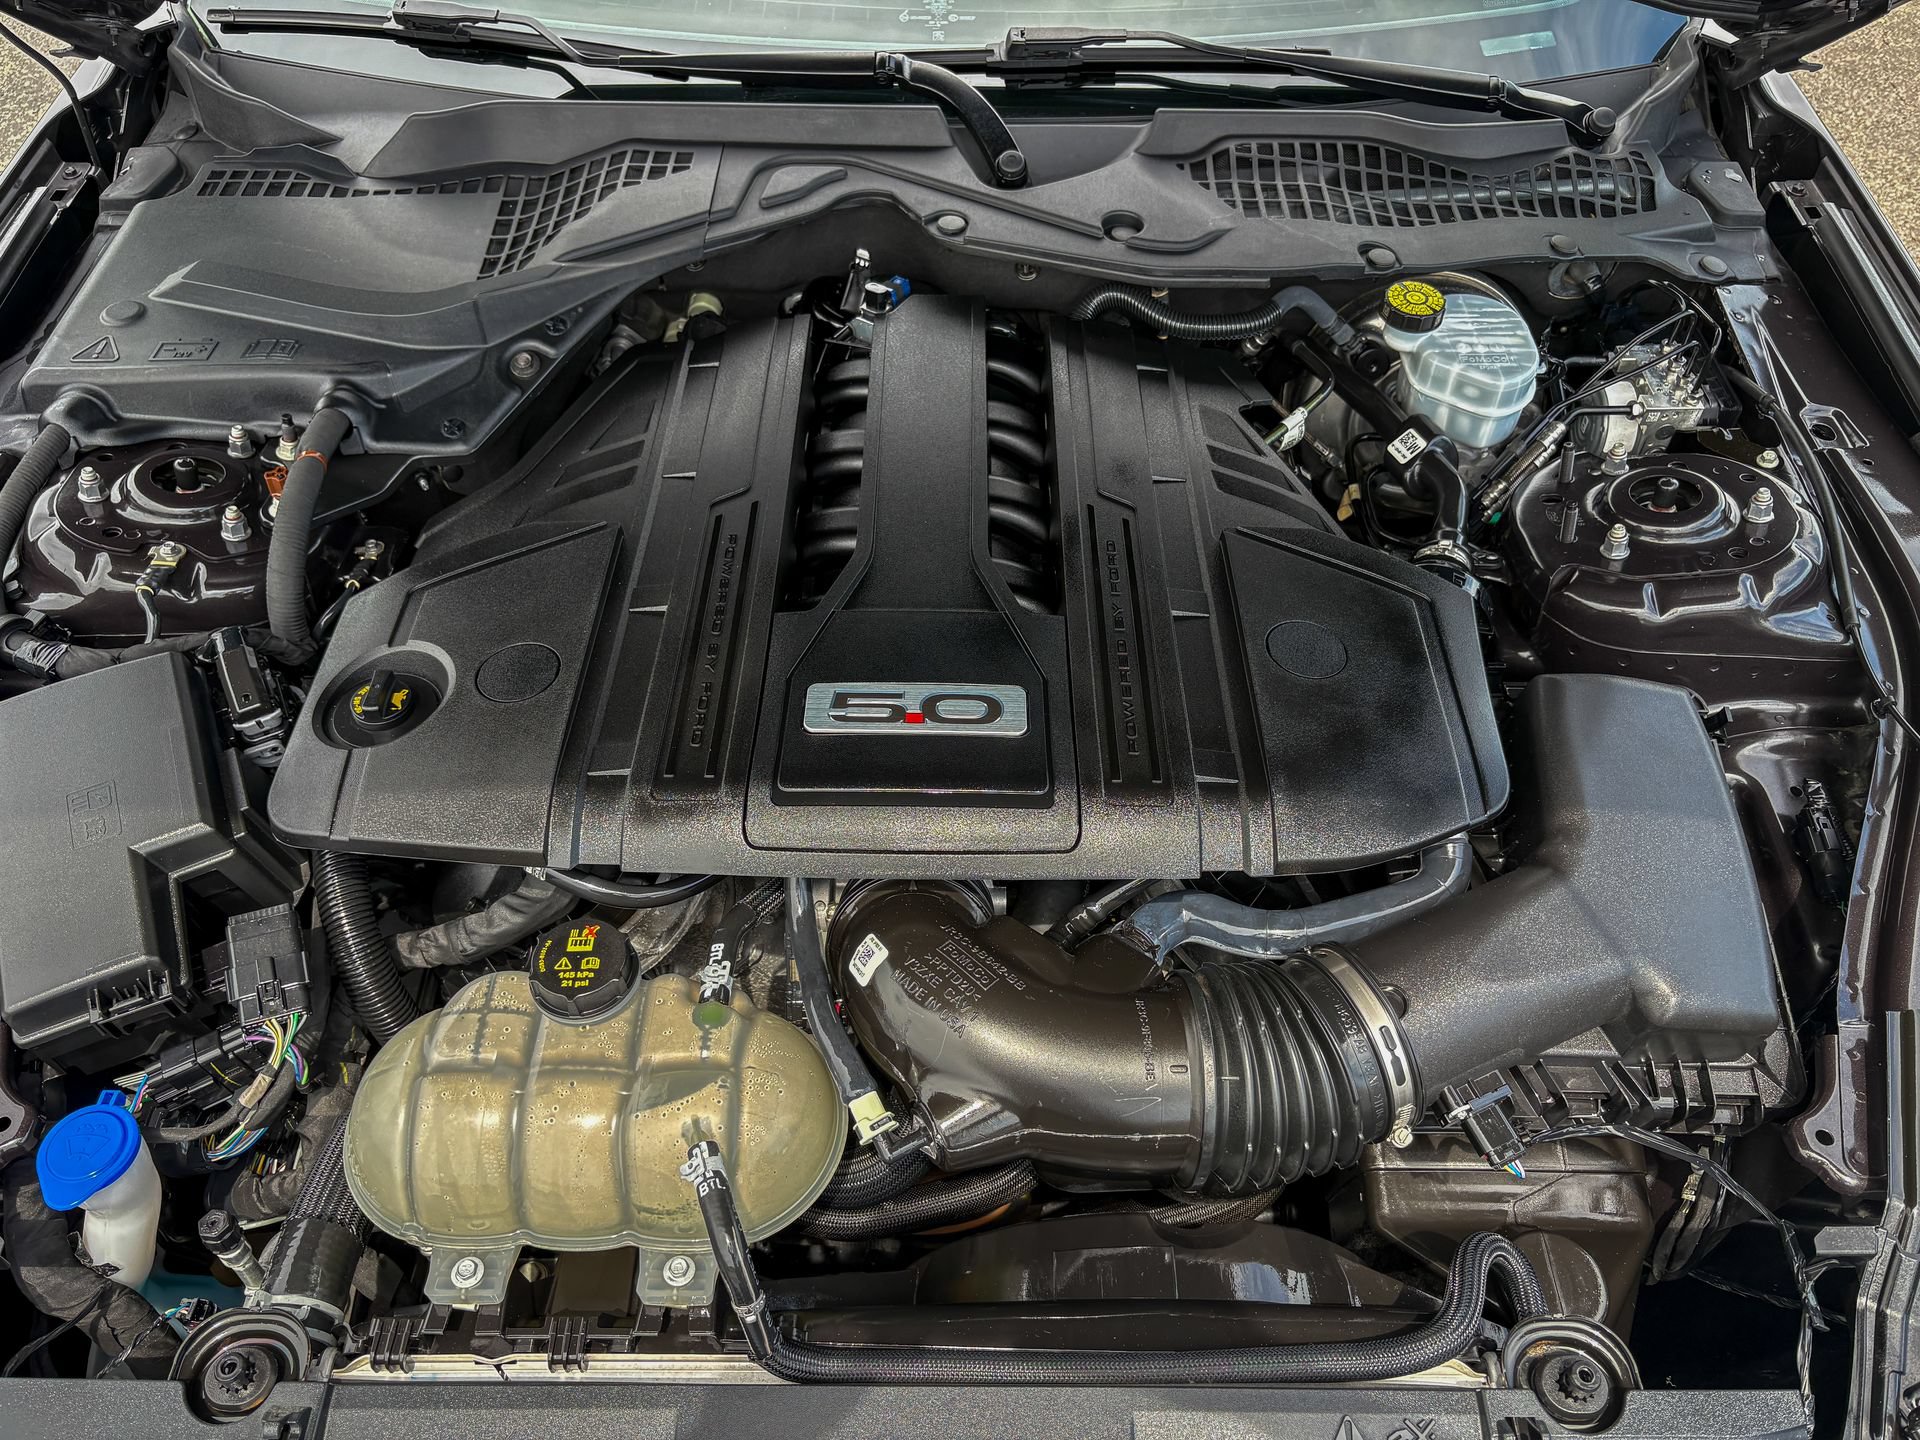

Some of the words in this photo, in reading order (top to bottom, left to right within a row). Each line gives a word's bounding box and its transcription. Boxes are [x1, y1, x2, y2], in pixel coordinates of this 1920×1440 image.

[1461, 355, 1508, 363] FoMoCo
[711, 533, 737, 635] POWERED
[1106, 540, 1121, 595] FORD
[1112, 602, 1126, 632] BY
[704, 643, 719, 673] BY
[689, 681, 712, 747] FORD
[827, 690, 1005, 725] 5.0
[1116, 639, 1140, 756] POWERED
[574, 980, 589, 988] psi
[943, 944, 990, 984] FoMoCo
[891, 968, 928, 1001] MADE
[925, 996, 942, 1012] IN
[939, 1008, 967, 1038] USA
